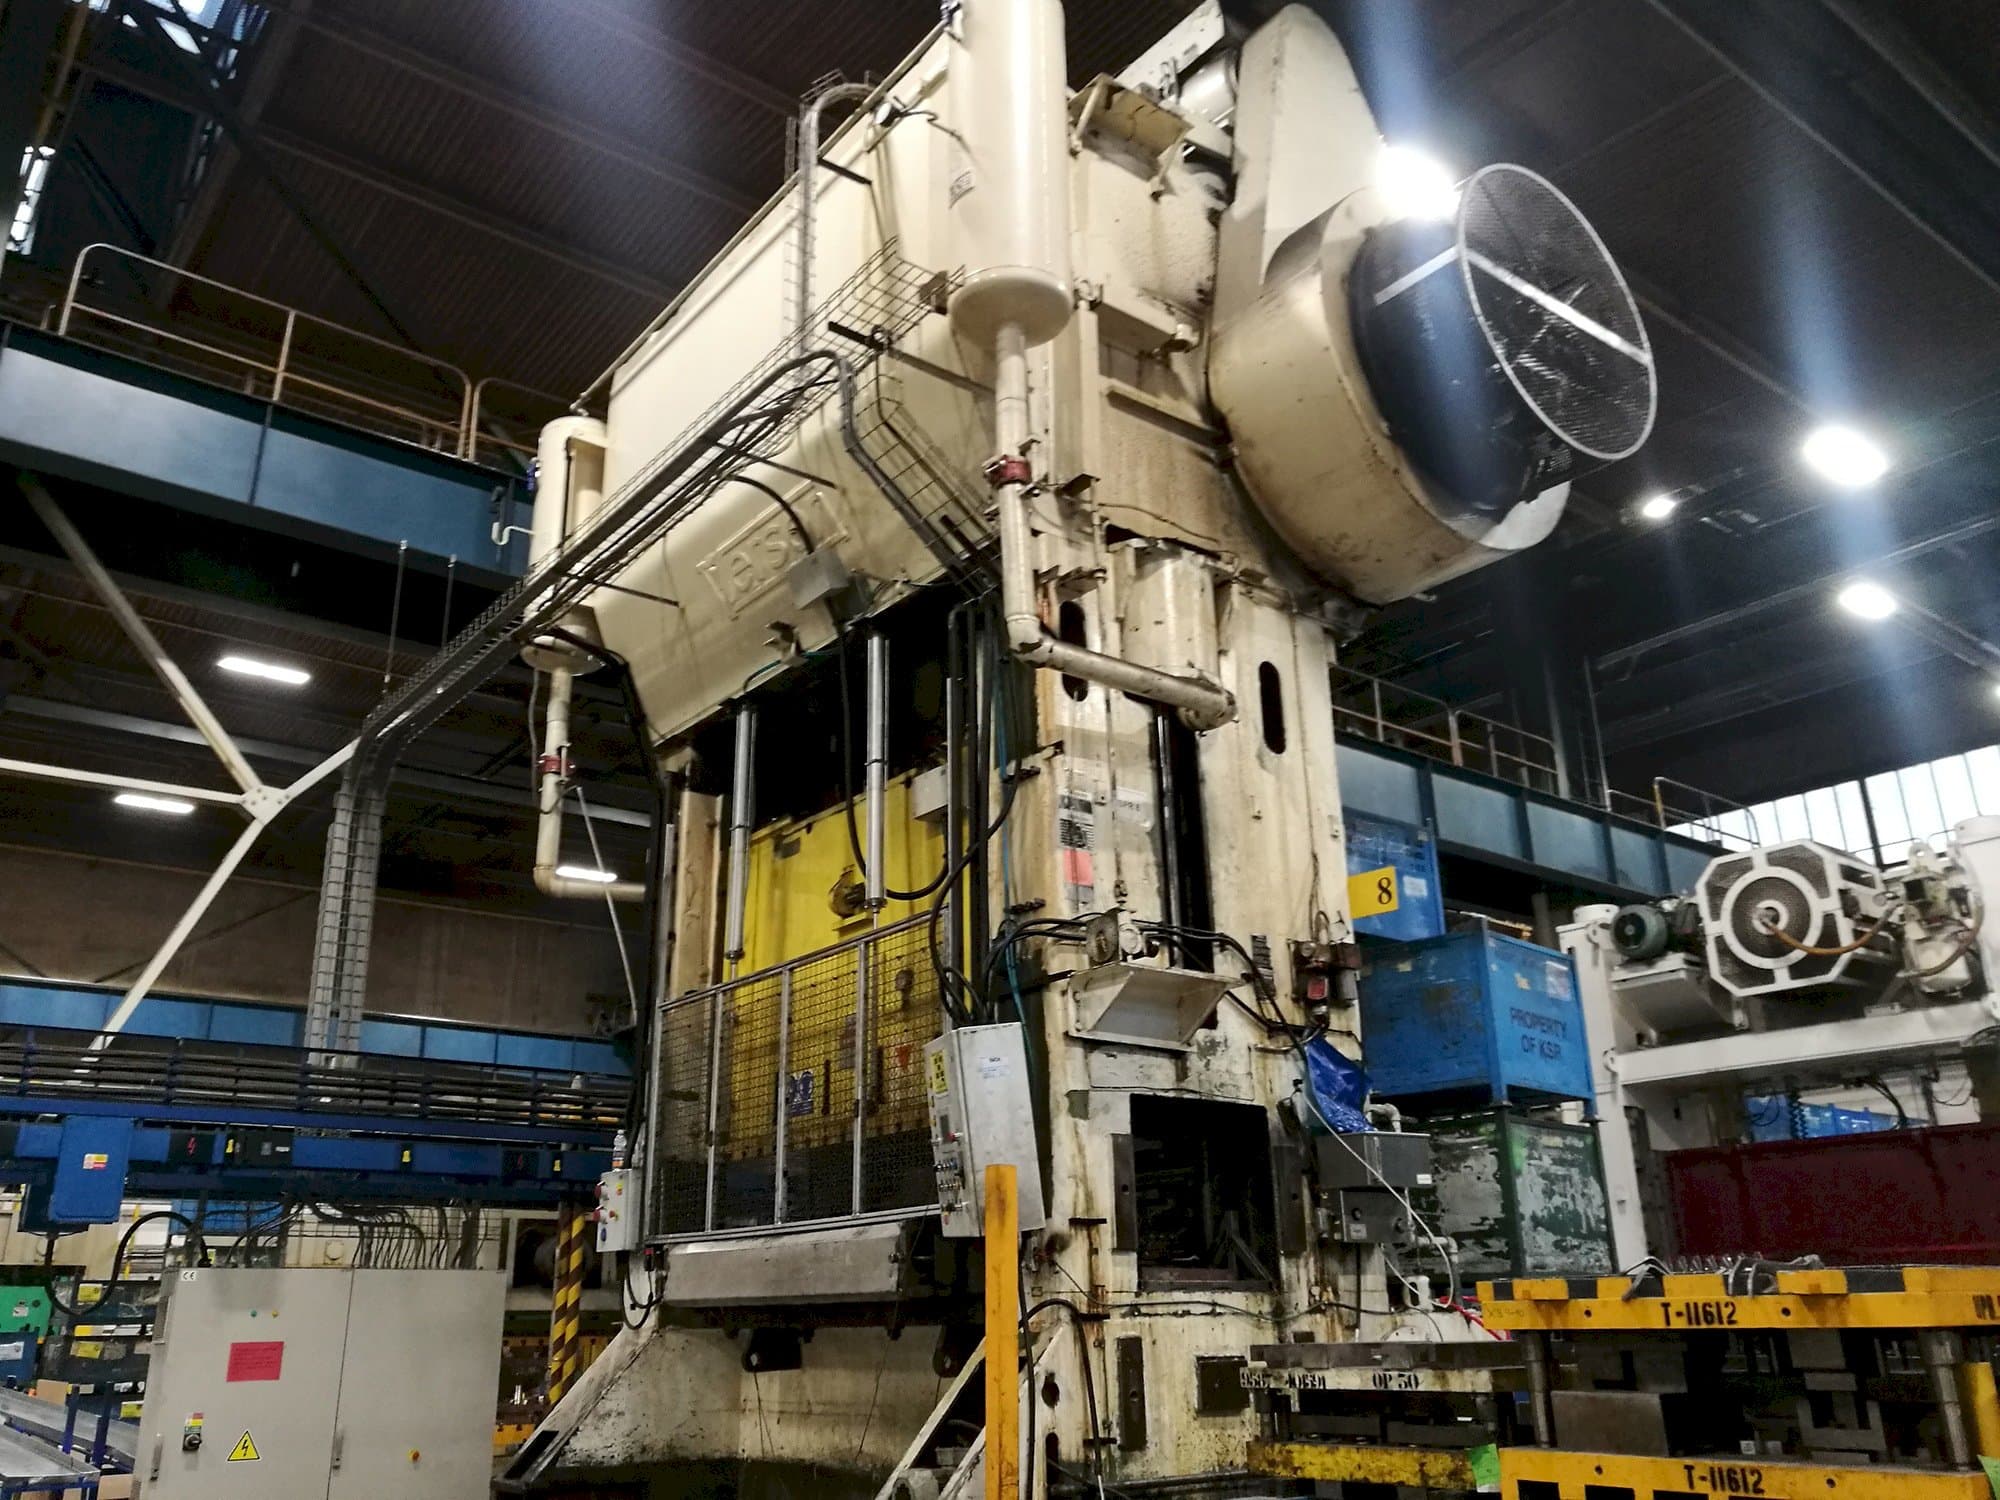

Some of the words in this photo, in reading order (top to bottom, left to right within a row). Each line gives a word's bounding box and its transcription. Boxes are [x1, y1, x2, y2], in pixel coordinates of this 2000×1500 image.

[1377, 876, 1393, 905] 8
[1509, 1006, 1568, 1040] PROPERTY
[1521, 1034, 1536, 1054] OF
[1660, 1301, 1738, 1327] T-11612
[1372, 1372, 1393, 1389] OP
[1683, 1463, 1766, 1494] T-11612
